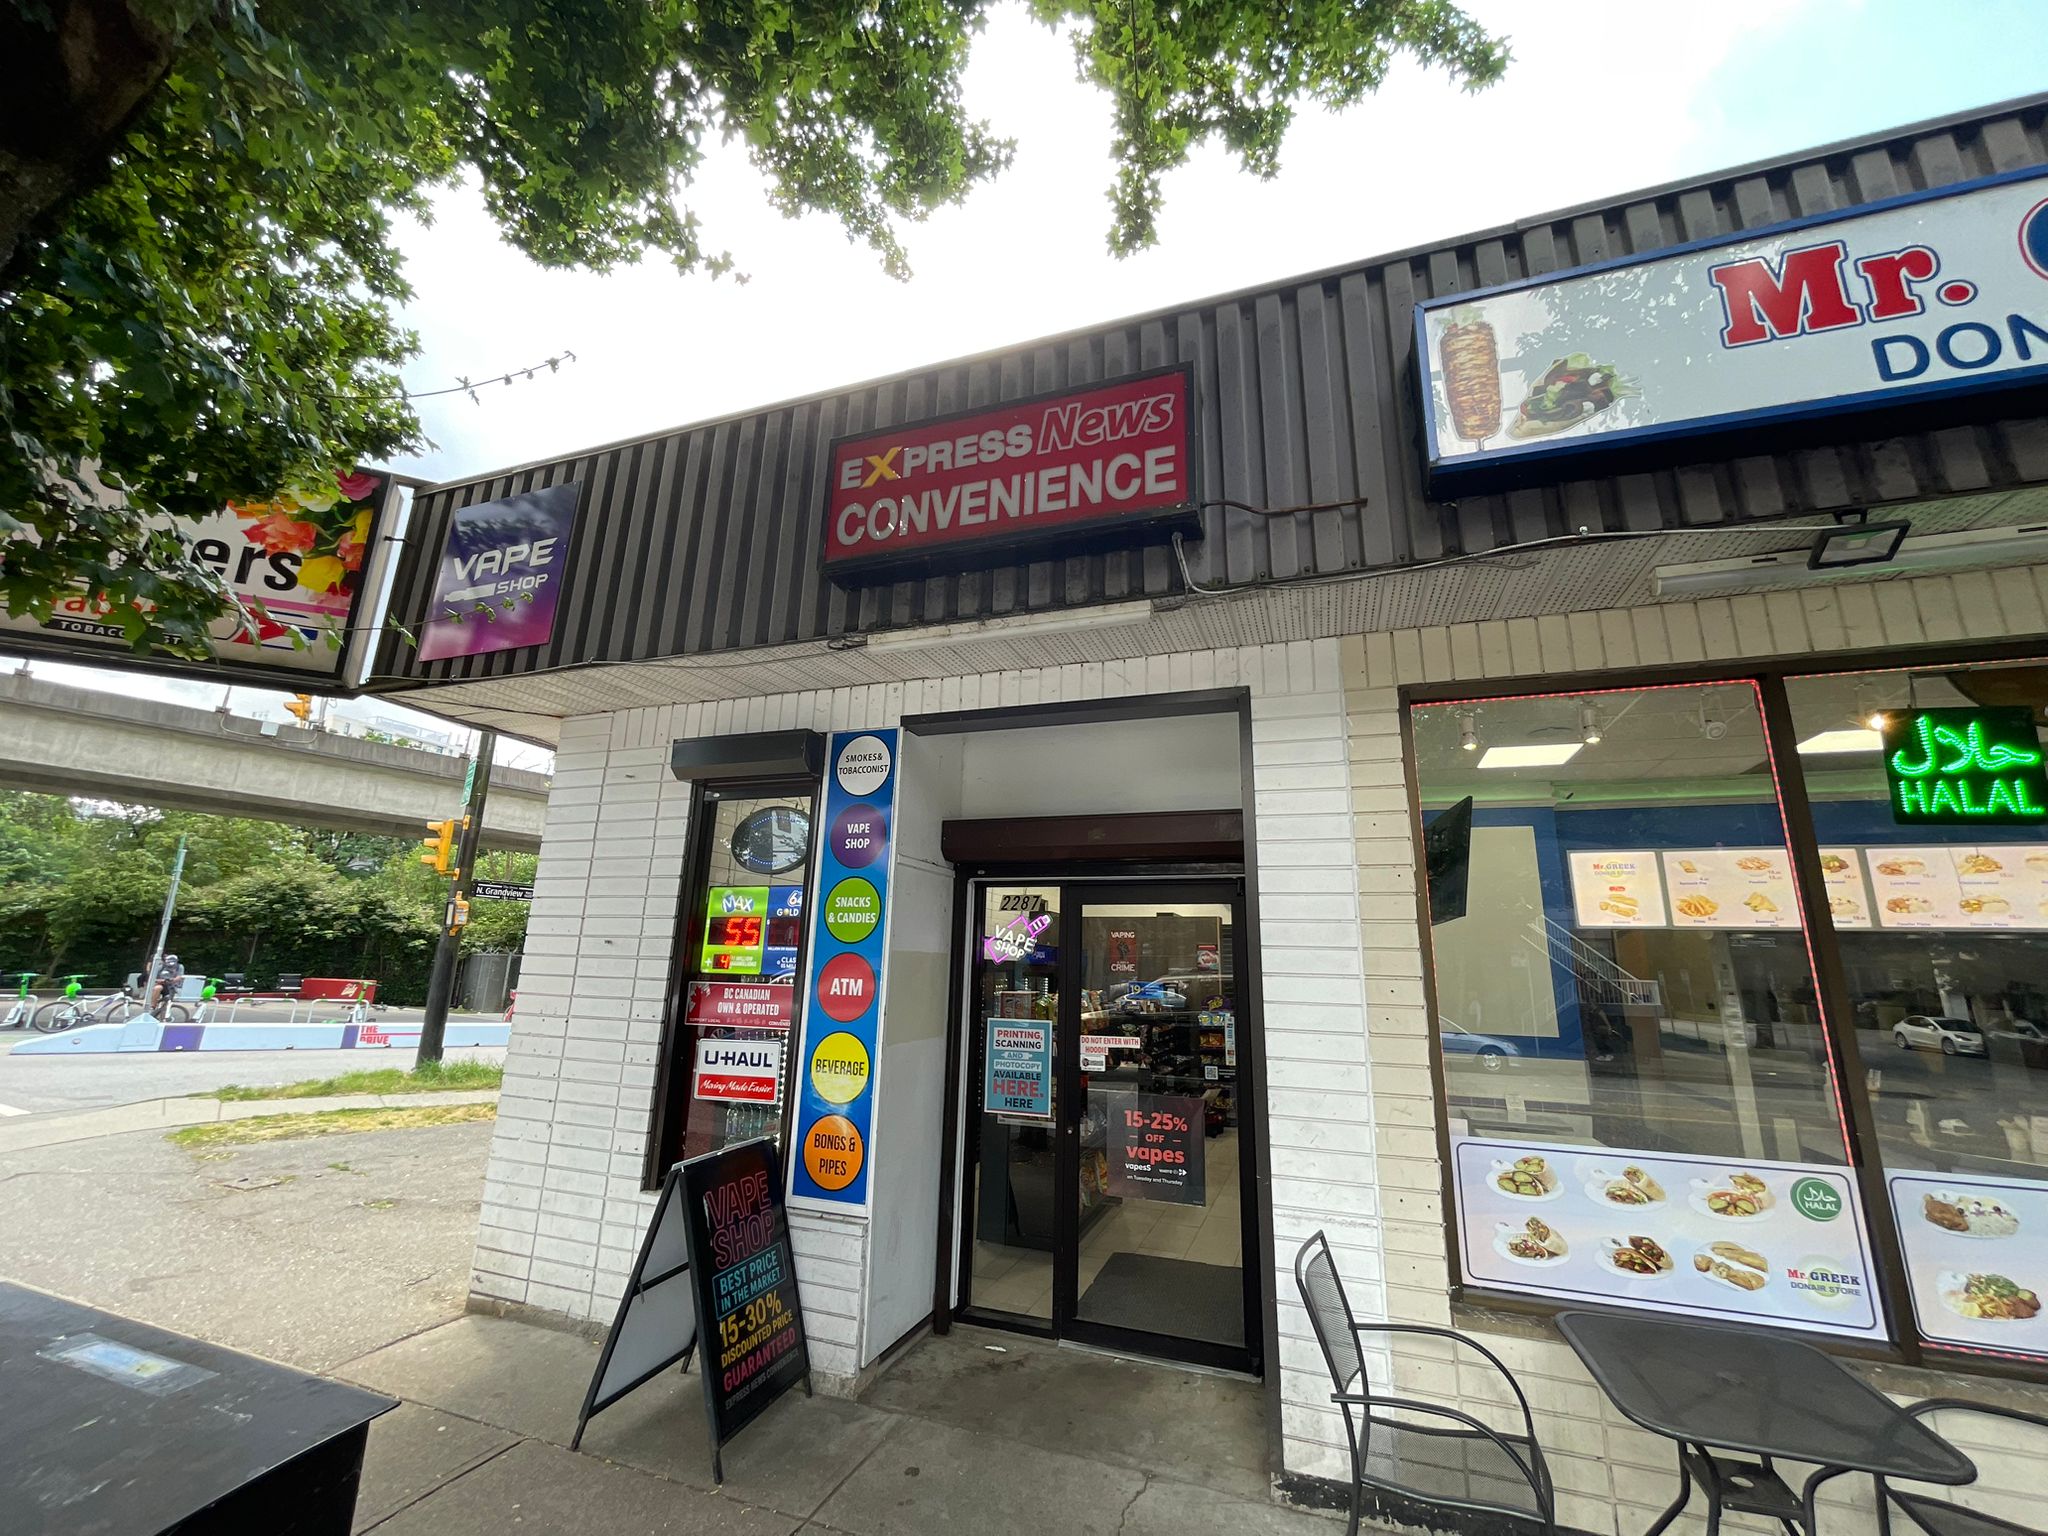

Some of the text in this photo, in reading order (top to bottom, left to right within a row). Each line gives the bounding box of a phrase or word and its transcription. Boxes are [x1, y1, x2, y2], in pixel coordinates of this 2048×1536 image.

[1708, 239, 1978, 349] Mr.
[1871, 314, 2048, 381] DON
[840, 393, 1176, 489] EXPRESS News
[836, 445, 1177, 545] CONVENIENCE
[453, 537, 558, 581] VAPE
[496, 573, 548, 595] SHOP
[838, 764, 889, 775] TOBACCONIST
[1898, 778, 2046, 814] HALAL
[847, 823, 870, 834] VAPE
[845, 837, 870, 849] SHOP
[476, 886, 484, 894] N.
[485, 887, 523, 898] Grandview
[722, 894, 754, 912] MAX
[835, 896, 871, 908] SNACKS
[1001, 895, 1040, 911] 2287
[828, 912, 876, 924] & CANDIES
[724, 917, 761, 946] 55
[995, 925, 1036, 952] VAPE
[1111, 931, 1135, 939] VAPING
[994, 940, 1025, 959] SHOP
[1111, 963, 1135, 972] CRIME
[724, 987, 770, 1001] BC CANADIAN
[830, 978, 863, 996] ATM
[717, 1001, 779, 1016] OWN & OPERATED
[361, 1025, 379, 1033] THE
[997, 1029, 1043, 1041] PRINTING,
[360, 1035, 389, 1045] DRIVE
[995, 1039, 1042, 1050] SCANNING
[1081, 1036, 1139, 1046] DO NOT ENTER WITH
[704, 1050, 772, 1068] U-HAUL
[815, 1058, 865, 1077] BEVERAGE
[995, 1060, 1041, 1070] PHOTOCOPY
[993, 1070, 1042, 1081] AVAILABLE
[700, 1079, 726, 1093] Moving
[726, 1080, 747, 1091] Made
[993, 1079, 1044, 1098] HERE.
[1004, 1097, 1033, 1109] HERE
[1124, 1109, 1188, 1132] 15-25%
[813, 1133, 855, 1152] BONGS &
[1145, 1133, 1165, 1143] OFF
[1125, 1145, 1185, 1166] vapes
[818, 1158, 847, 1176] PIPES
[1133, 1174, 1152, 1183] Tuesday
[1161, 1178, 1183, 1186] Thursday
[704, 1170, 772, 1230] VAPE
[1804, 1201, 1838, 1212] HALAL
[713, 1209, 776, 1270] SHOP
[720, 1250, 778, 1296] BEST PRICE
[1809, 1271, 1861, 1286] GREEK
[721, 1267, 781, 1313] IN THE MARKET
[1790, 1281, 1862, 1297] DONAIR STORE
[720, 1290, 782, 1348] 15-30%
[721, 1309, 794, 1369] DISCOUNTED PRICE
[723, 1327, 796, 1393] GUARANTEED
